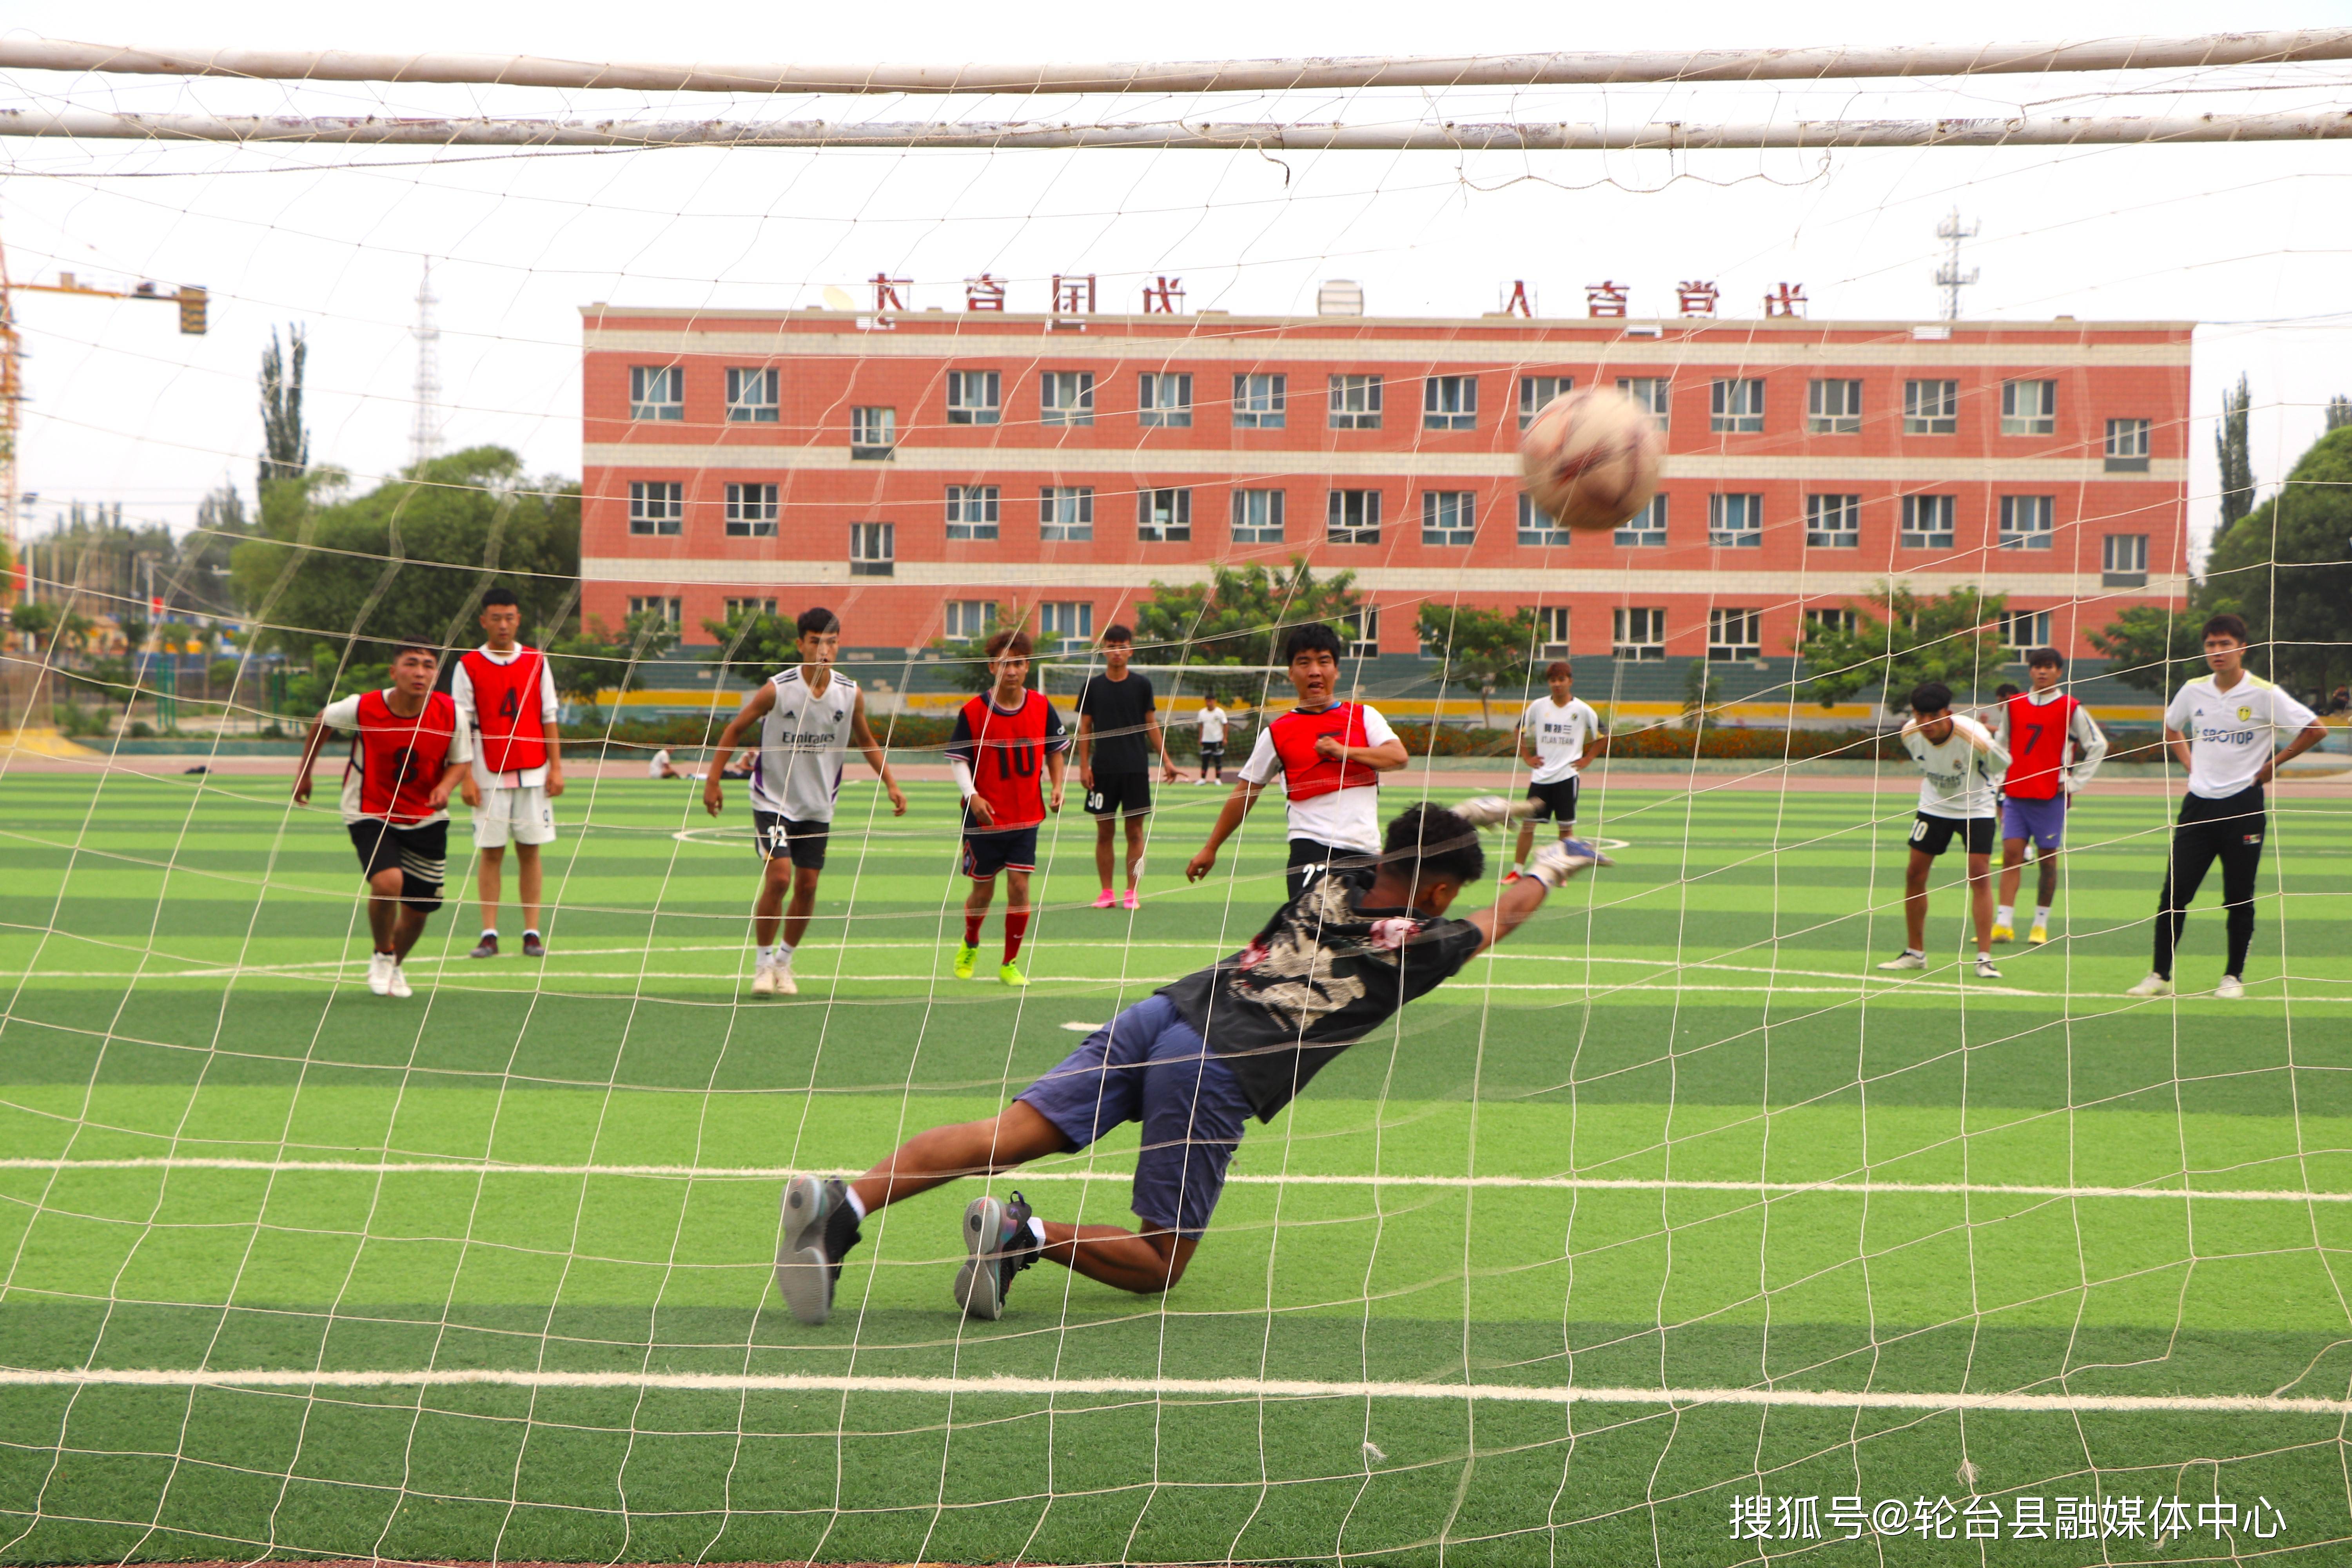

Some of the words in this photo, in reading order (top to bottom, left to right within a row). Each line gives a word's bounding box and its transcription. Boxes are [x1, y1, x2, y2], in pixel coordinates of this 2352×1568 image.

[500, 687, 520, 722] 4
[2024, 724, 2043, 755] 7
[2202, 729, 2254, 744] SBOTOP
[394, 746, 418, 784] 8
[997, 737, 1035, 779] 10
[1087, 791, 1104, 810] 30
